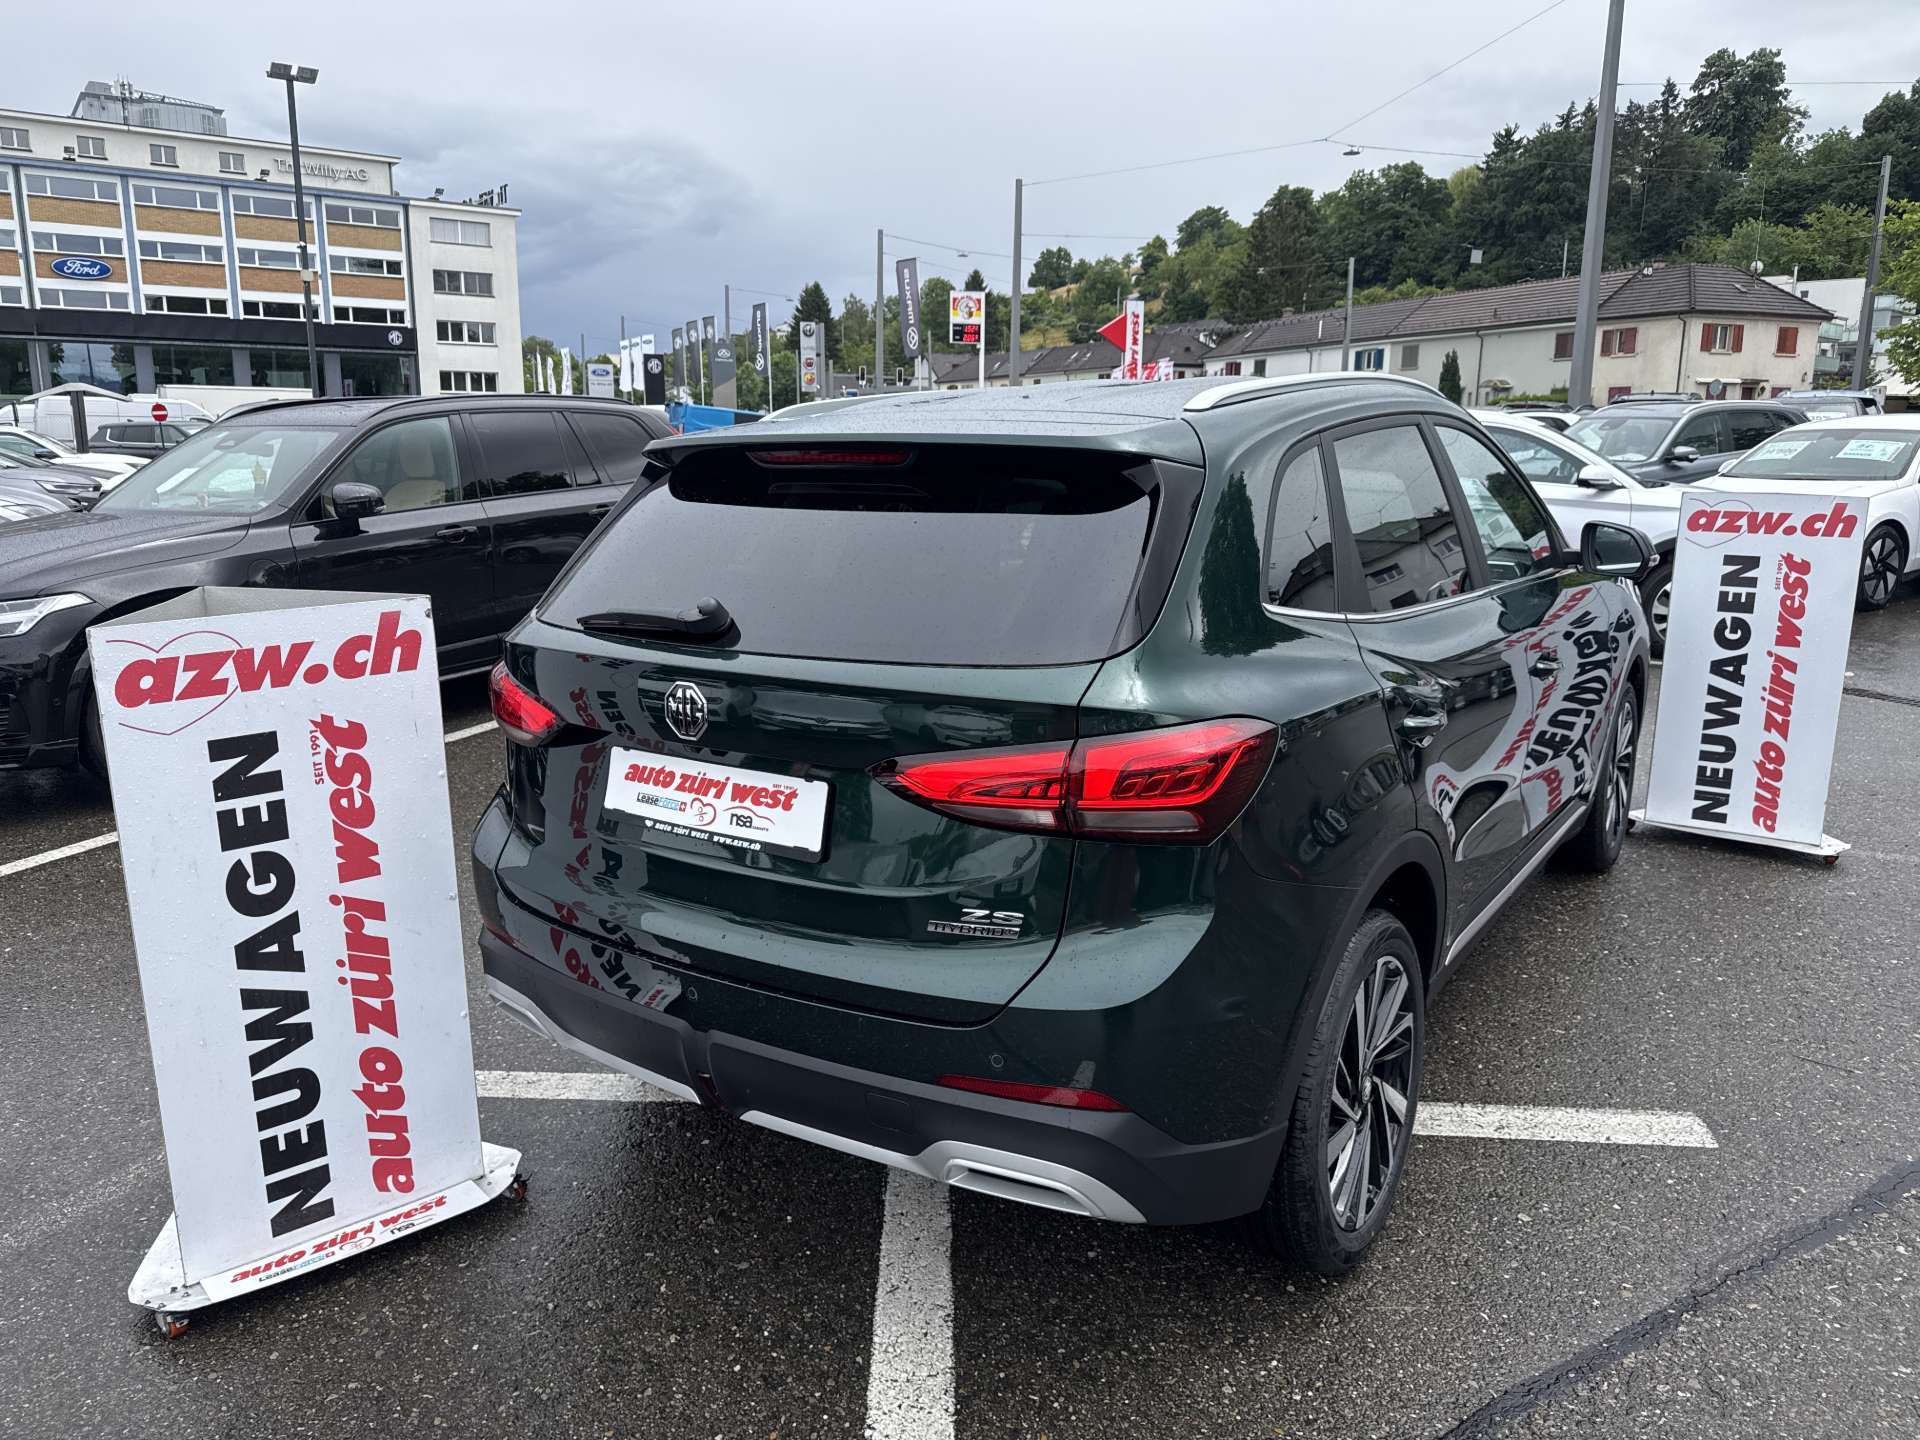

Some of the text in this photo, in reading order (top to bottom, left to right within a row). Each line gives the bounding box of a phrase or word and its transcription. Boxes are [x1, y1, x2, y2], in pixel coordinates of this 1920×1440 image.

[303, 161, 340, 181] Willy
[345, 167, 369, 181] AG
[63, 260, 101, 275] Ford
[1687, 503, 1858, 539] azw.ch
[115, 611, 422, 708] azw.ch
[1691, 554, 1761, 825] NEUWAGEN
[1752, 551, 1812, 834] auto züri west
[309, 729, 325, 785] SEIT 1991
[624, 763, 799, 811] auto züri west
[654, 822, 672, 833] auto
[672, 825, 690, 837] züri
[690, 830, 709, 840] west
[729, 813, 753, 829] nsa
[960, 908, 1025, 925] ZS
[308, 713, 415, 1195] auto züri west
[207, 730, 335, 1238] NEUWAGEN
[230, 1193, 448, 1283] auto züri west
